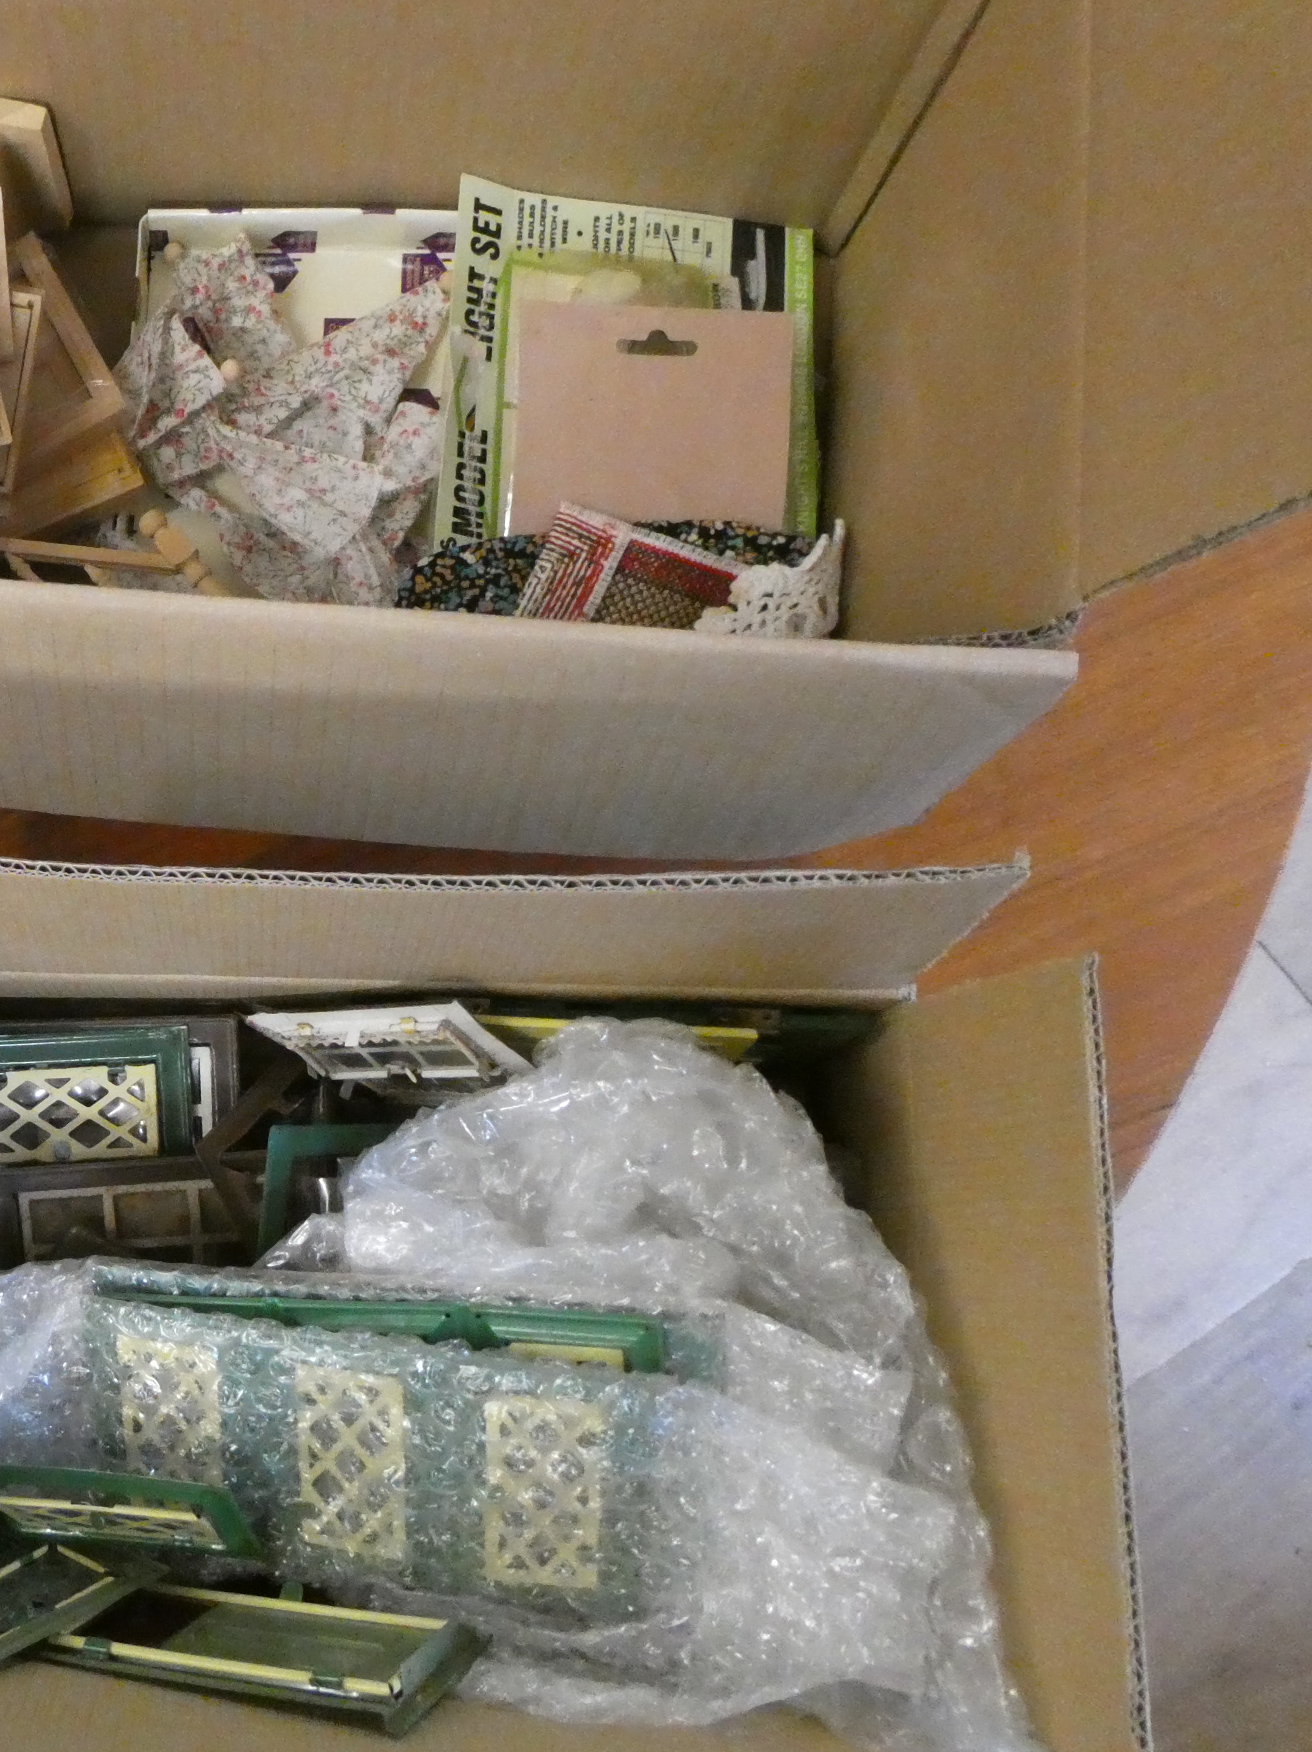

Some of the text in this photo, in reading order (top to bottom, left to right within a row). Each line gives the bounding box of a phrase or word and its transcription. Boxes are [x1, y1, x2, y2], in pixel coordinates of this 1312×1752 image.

[516, 198, 525, 242] SHADES
[528, 203, 536, 240] BULBS
[538, 199, 548, 249] HOLDERS
[561, 218, 570, 246] WIRE
[604, 213, 614, 255] OR ALL
[617, 210, 626, 226] OF
[452, 429, 488, 540] MODEL
[470, 196, 503, 261] SET
